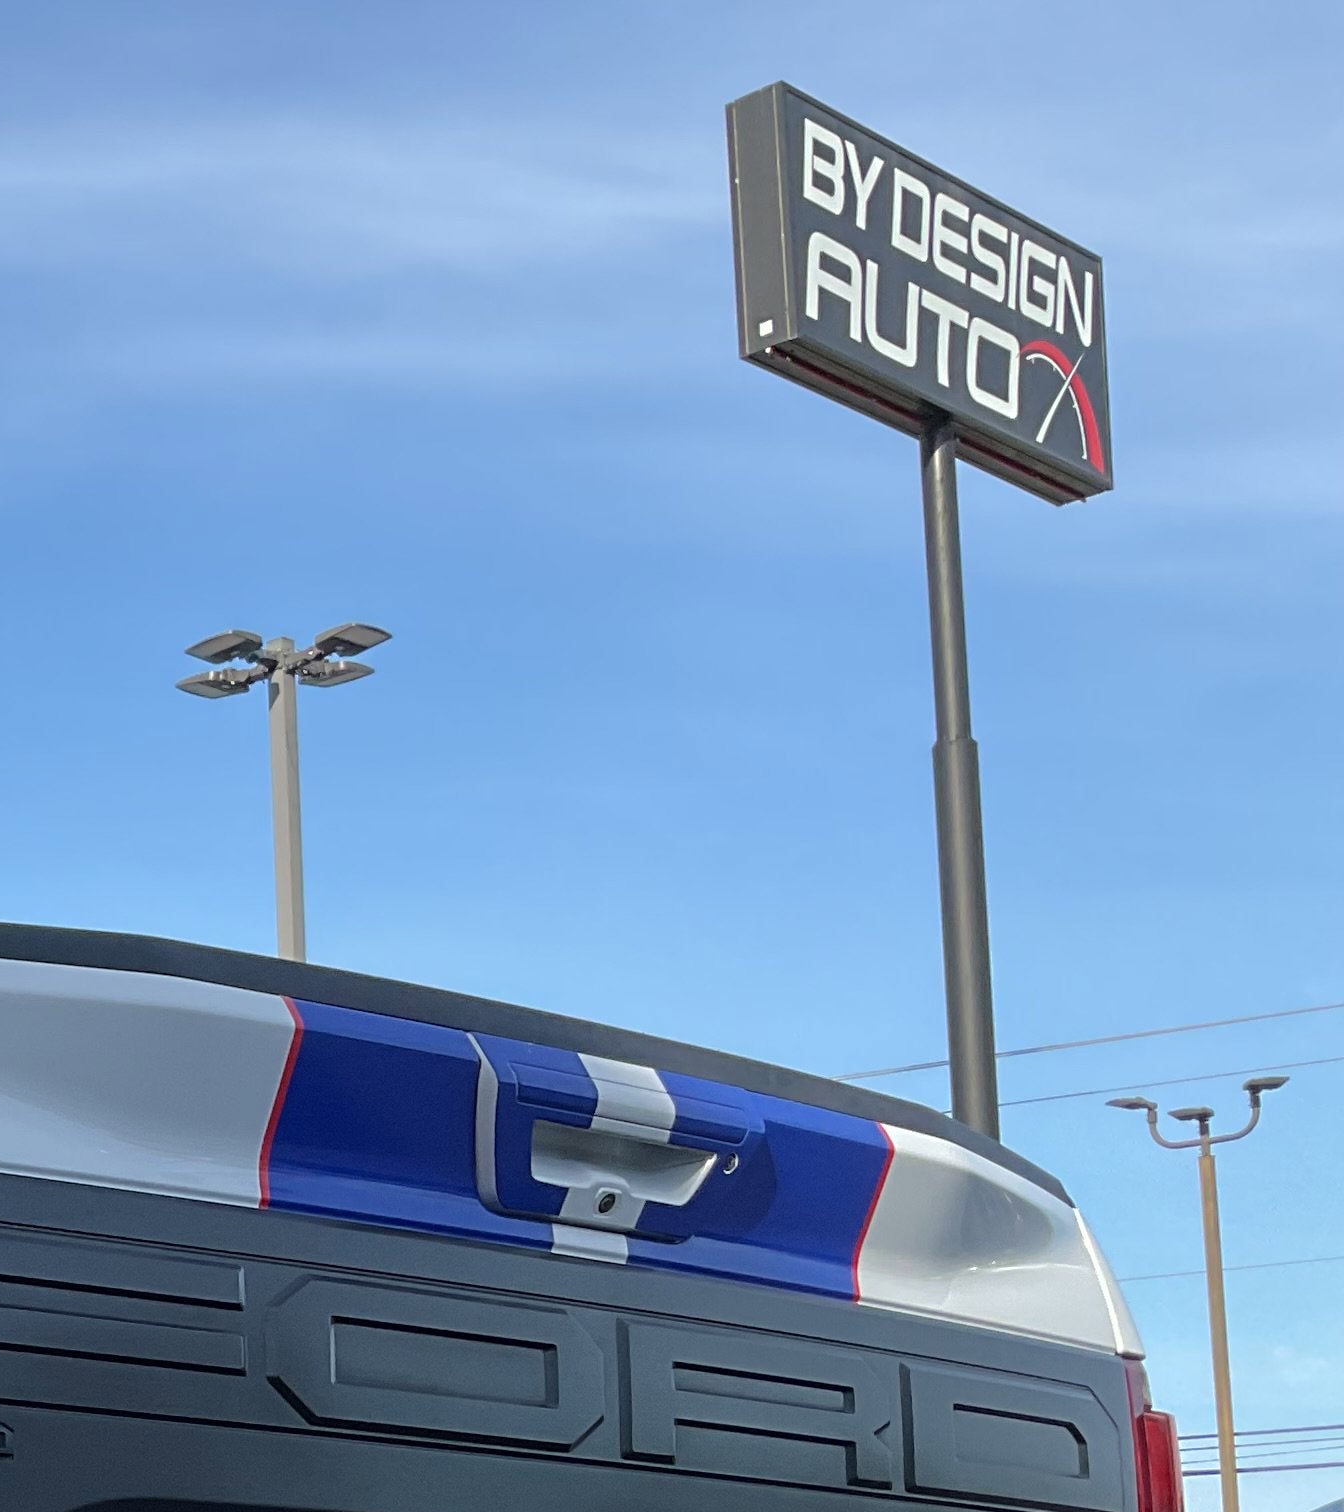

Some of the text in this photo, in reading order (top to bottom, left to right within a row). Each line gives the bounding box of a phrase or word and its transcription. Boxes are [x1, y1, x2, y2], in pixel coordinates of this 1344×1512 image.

[803, 117, 1094, 348] BY DESIGN
[805, 231, 1021, 420] AUTO
